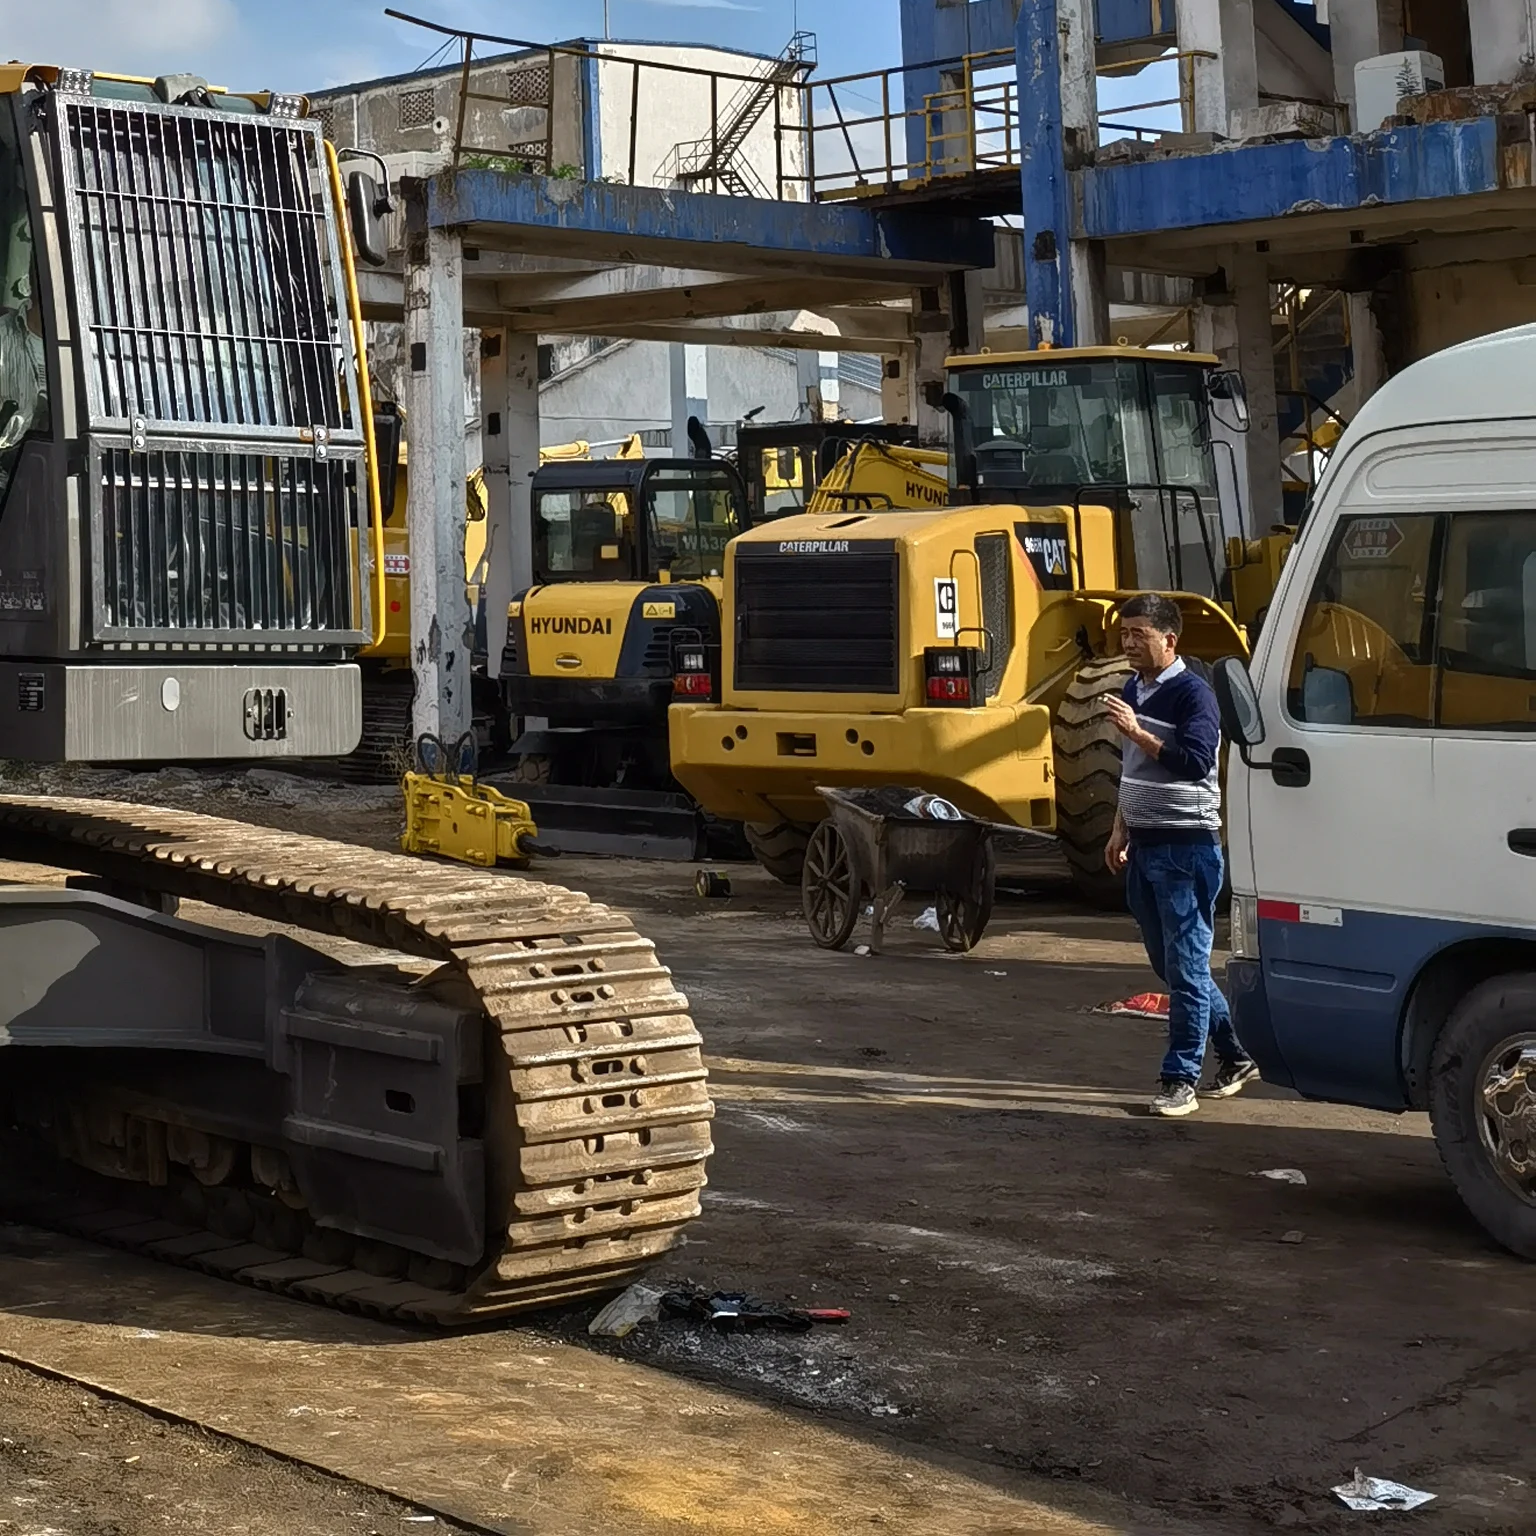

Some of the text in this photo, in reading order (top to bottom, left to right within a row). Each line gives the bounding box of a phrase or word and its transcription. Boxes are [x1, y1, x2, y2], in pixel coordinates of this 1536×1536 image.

[982, 370, 1068, 389] CATERPILLAR
[779, 541, 849, 553] CATERPILLAR
[1043, 538, 1067, 574] CAT
[531, 617, 612, 635] HYUNDAI
